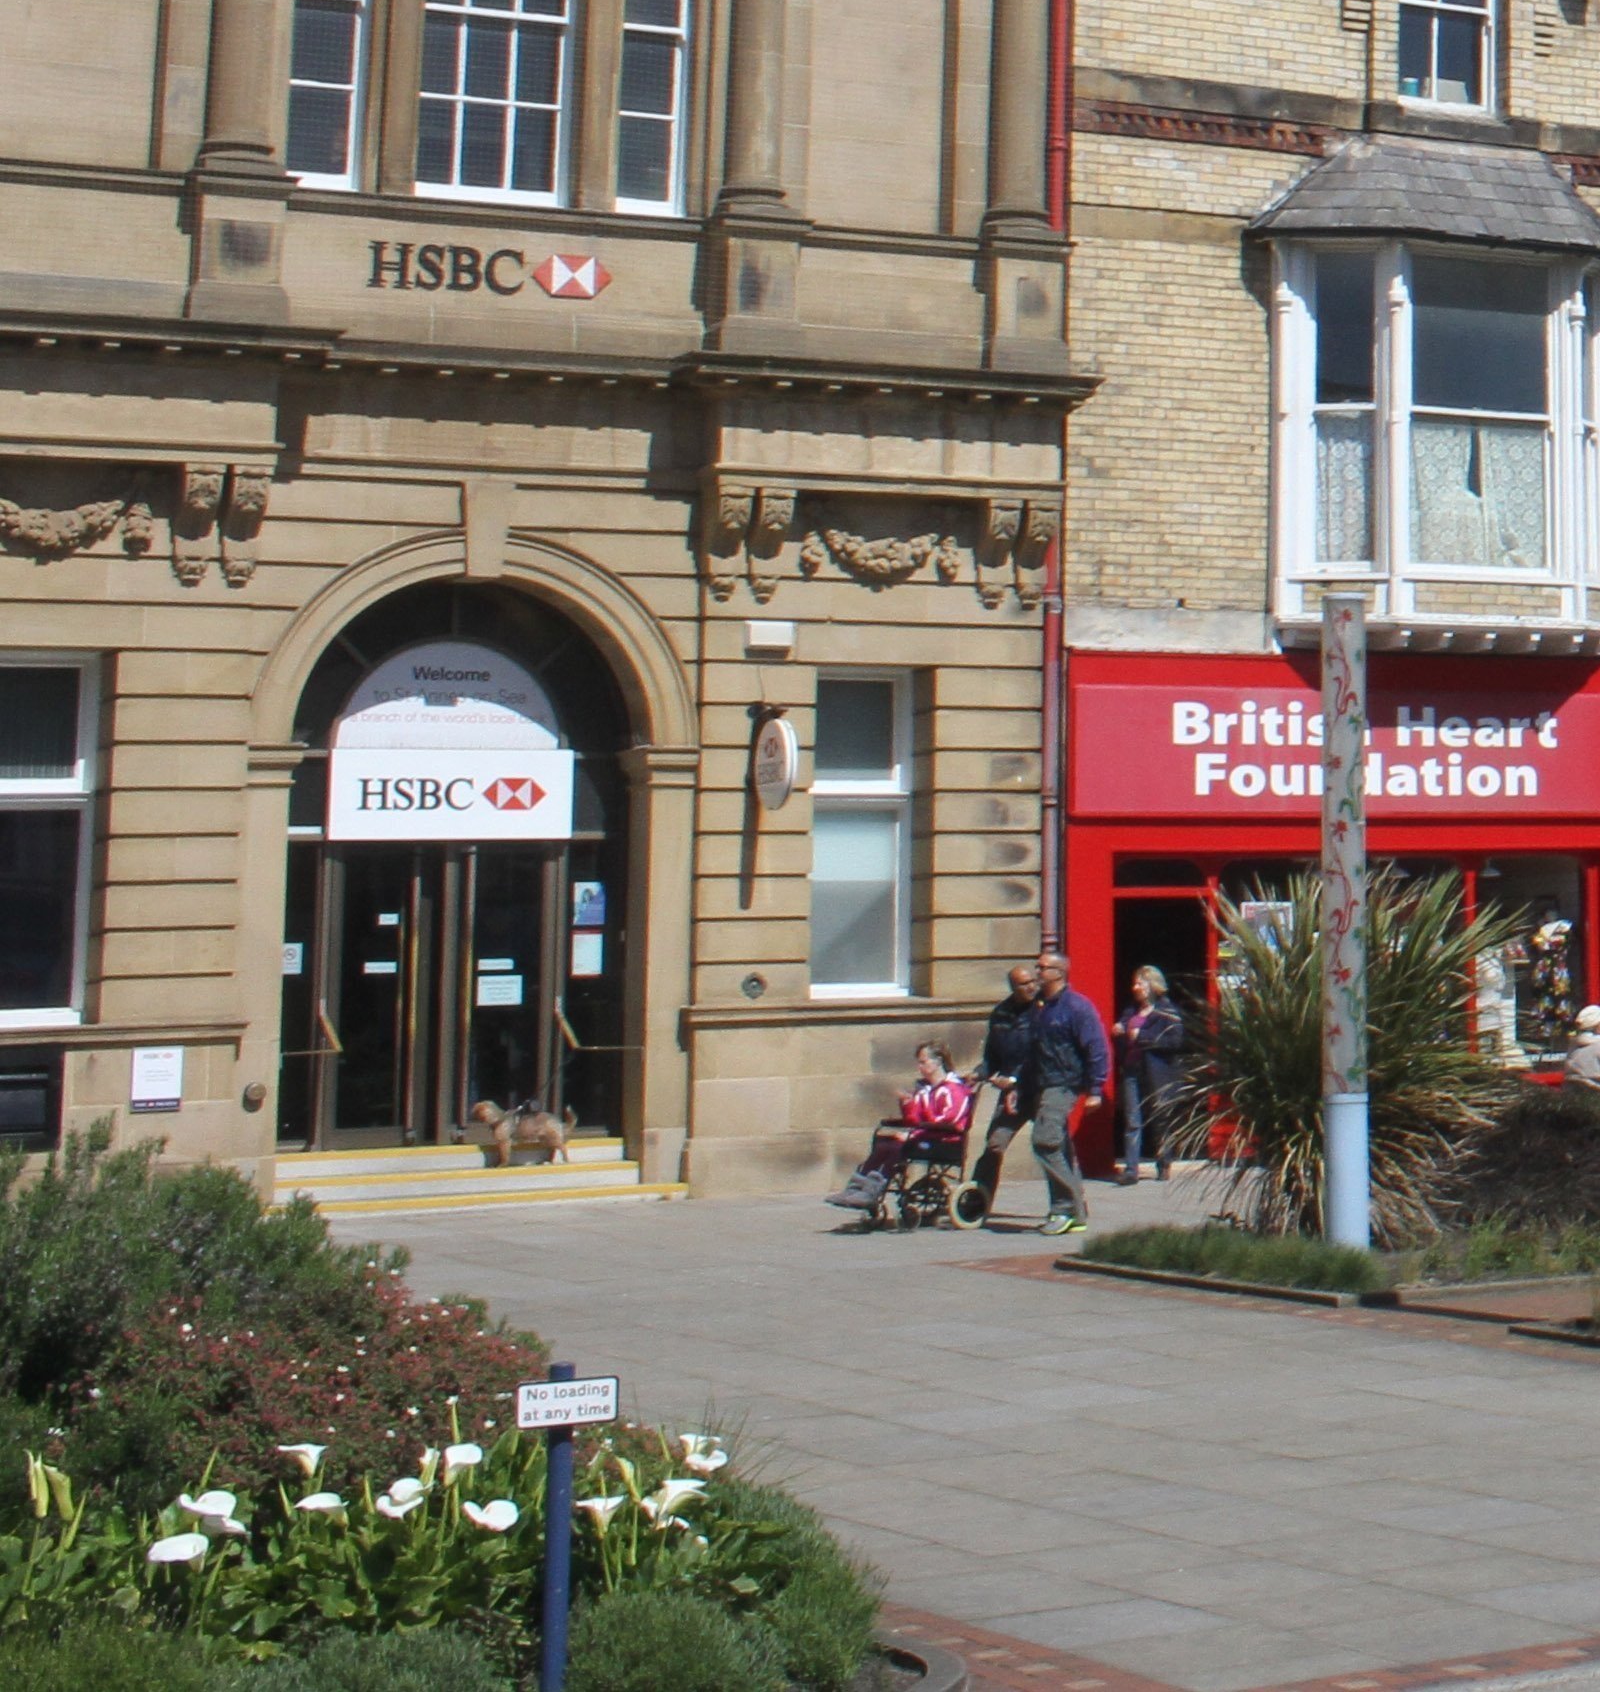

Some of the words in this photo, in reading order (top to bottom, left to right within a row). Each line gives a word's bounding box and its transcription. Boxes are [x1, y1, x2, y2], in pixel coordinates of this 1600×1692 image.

[367, 240, 526, 296] HSBC
[413, 665, 492, 682] Welcome
[1396, 706, 1558, 748] Heart
[357, 777, 475, 811] HSBC
[525, 1388, 549, 1402] No
[553, 1383, 611, 1399] loading
[523, 1409, 540, 1422] at
[545, 1408, 572, 1421] any
[577, 1403, 611, 1417] time
